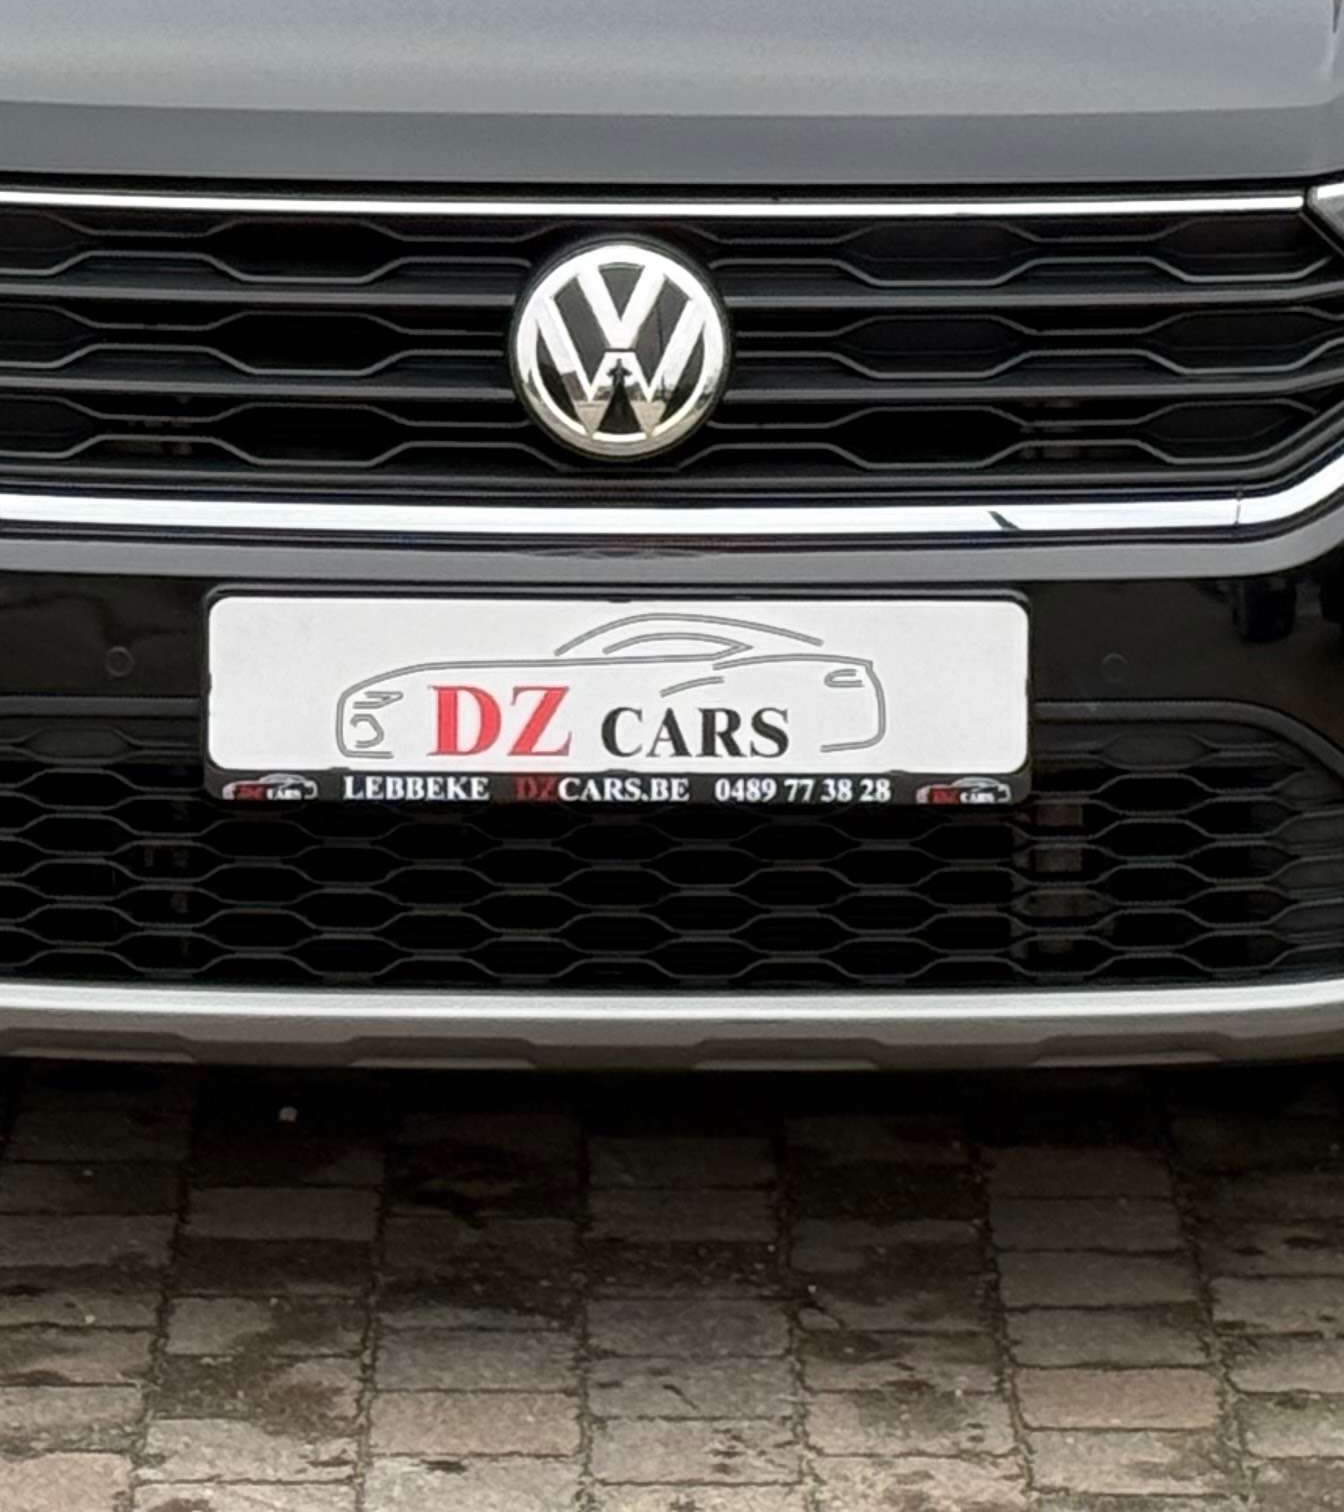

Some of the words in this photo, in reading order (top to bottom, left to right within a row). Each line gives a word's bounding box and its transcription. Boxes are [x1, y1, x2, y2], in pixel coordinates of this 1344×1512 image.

[430, 684, 572, 757] DZ
[601, 707, 790, 758] CARS
[343, 775, 490, 800] LEBBEKE
[714, 777, 777, 803] 0489
[784, 777, 816, 803] 77
[820, 777, 854, 803] 38
[859, 778, 892, 803] 28
